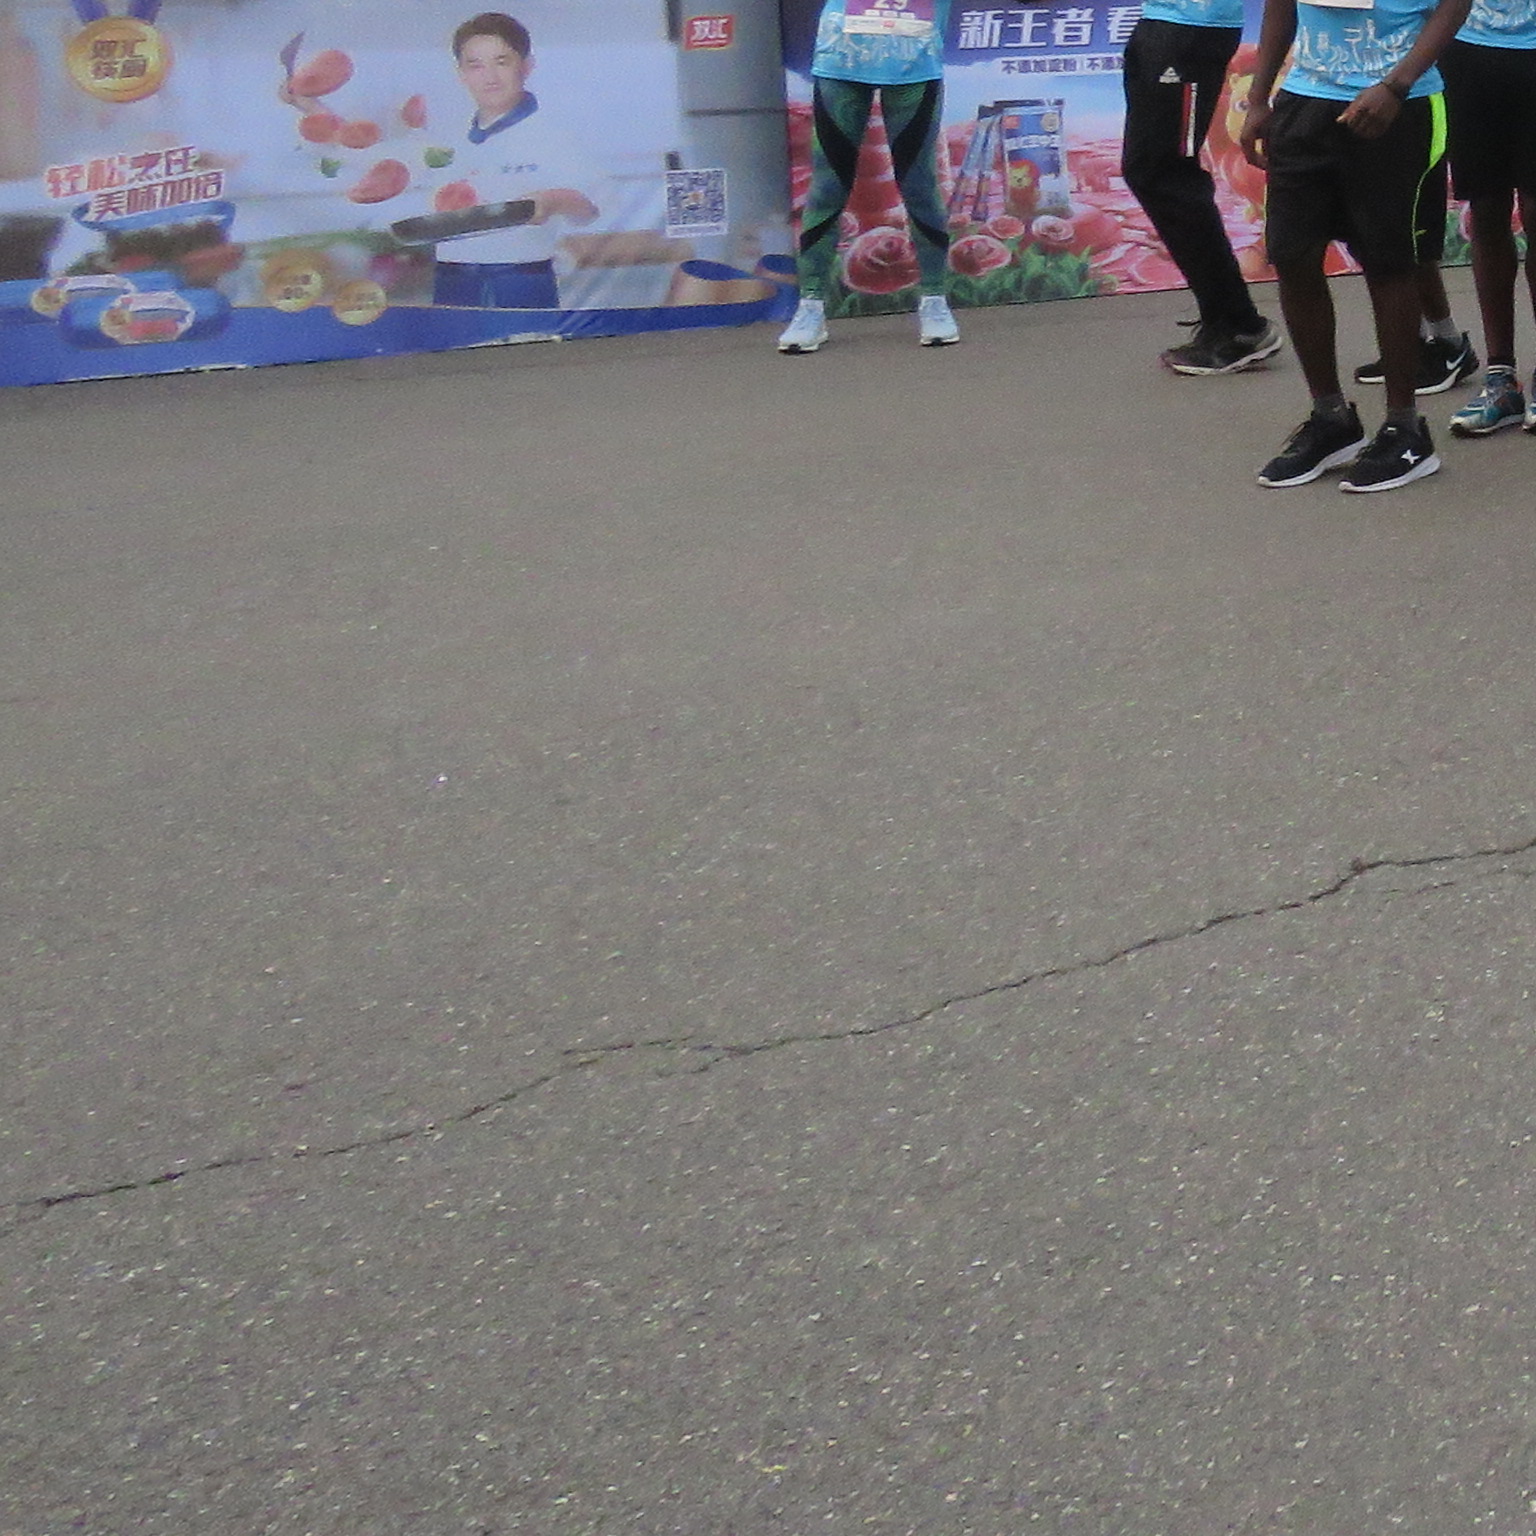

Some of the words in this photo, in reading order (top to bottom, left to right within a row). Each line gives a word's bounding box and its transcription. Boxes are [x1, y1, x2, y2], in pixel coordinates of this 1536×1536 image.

[958, 8, 1094, 50] 新王者
[92, 170, 225, 222] 美味加倍
